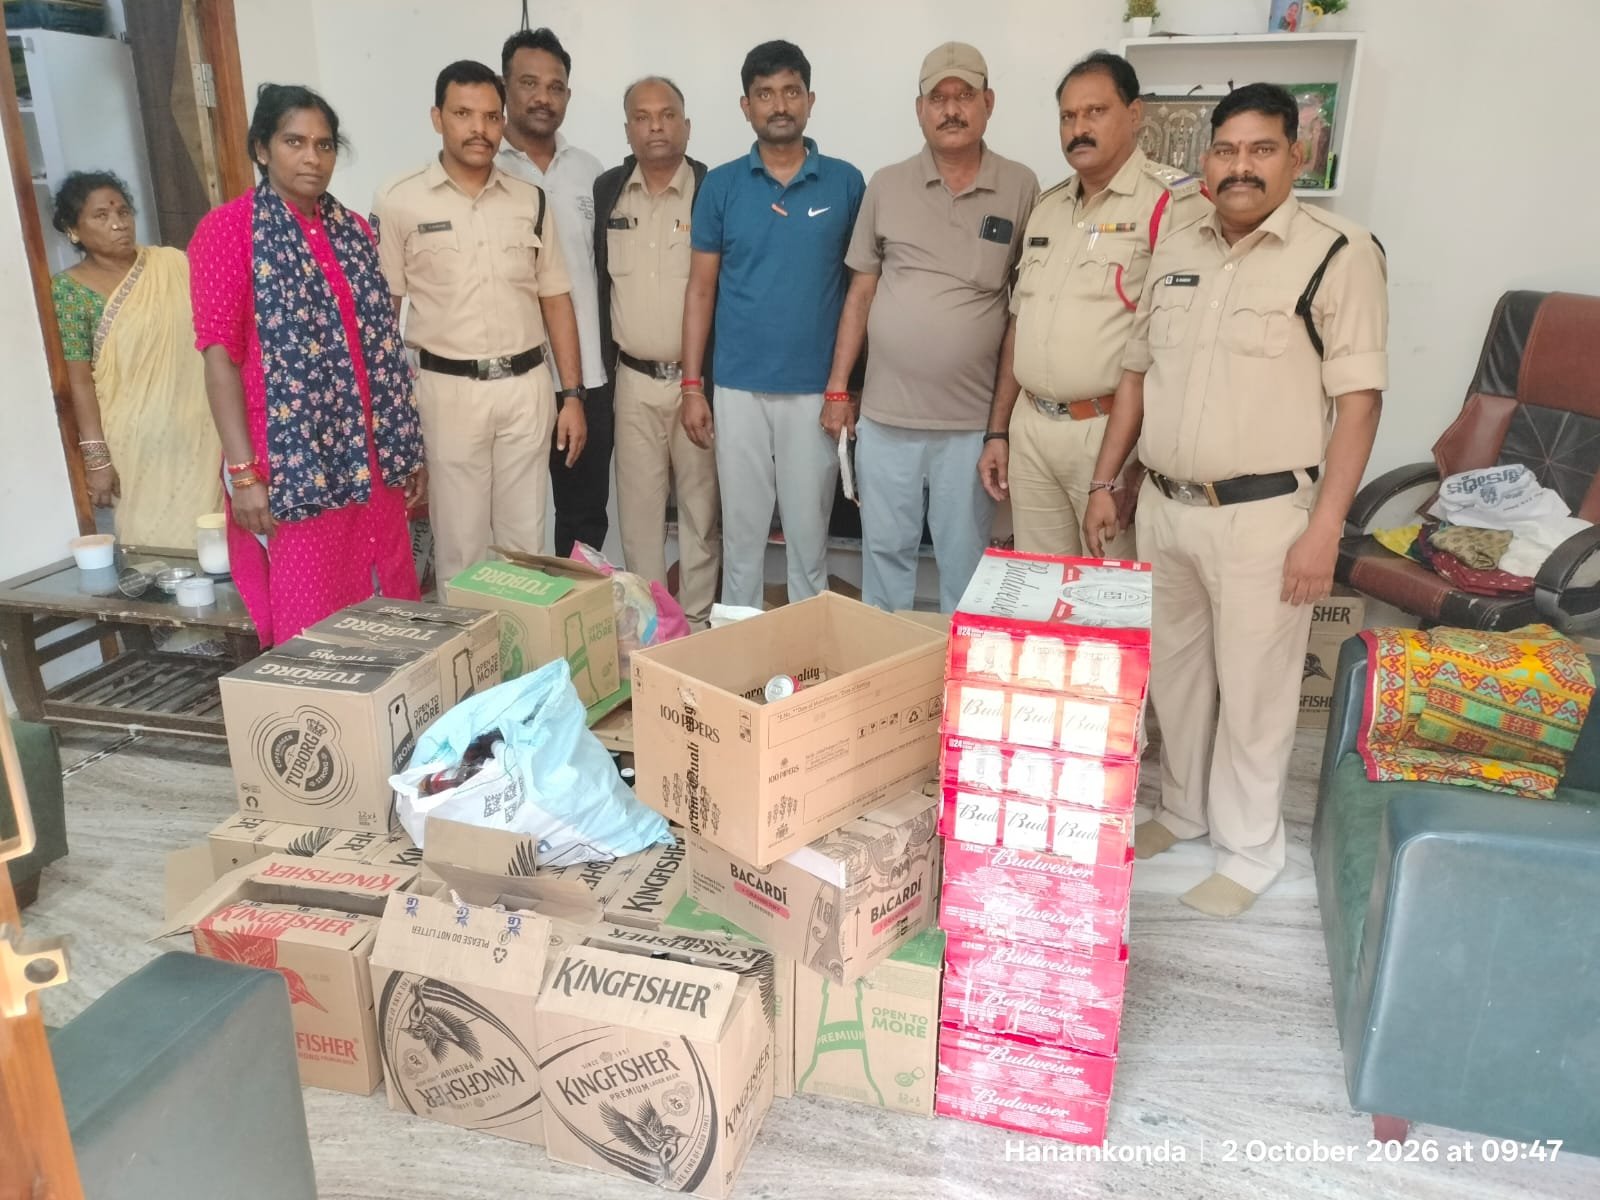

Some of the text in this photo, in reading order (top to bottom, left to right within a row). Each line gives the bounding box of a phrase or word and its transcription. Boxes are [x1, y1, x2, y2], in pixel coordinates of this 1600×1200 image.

[470, 566, 555, 596] TUBORG
[990, 558, 1051, 618] Budweiser
[333, 617, 438, 641] TUBORG
[308, 650, 377, 662] STRONG
[476, 653, 499, 673] OPEN TO
[255, 664, 366, 685] TUBORG
[477, 662, 499, 685] MORE
[413, 694, 440, 719] OPEN TO
[415, 704, 441, 731] MORE
[660, 704, 680, 725] 100
[285, 732, 320, 788] TUBORG
[261, 862, 400, 892] KINGFISHER
[988, 847, 1094, 879] Budweiser
[730, 862, 787, 905] BACARDÍ
[871, 872, 923, 923] BACARDÍ
[215, 903, 355, 937] KINGFISHER
[411, 925, 490, 949] PLEASE DO NOT LITTER
[988, 945, 1094, 977] Budweiser
[552, 956, 712, 1019] KINGFISHER
[871, 1006, 929, 1026] OPEN TO
[980, 989, 1085, 1022] Budweiser
[871, 1017, 927, 1039] MORE
[295, 1031, 359, 1062] FISHER
[983, 1045, 1086, 1077] Budweiser
[415, 1057, 525, 1109] KINGFISHER
[439, 1060, 475, 1079] PREMIUM
[555, 1048, 681, 1106] KINGFISHER
[609, 1083, 650, 1101] PREMIUM
[971, 1085, 1071, 1118] Budweiser
